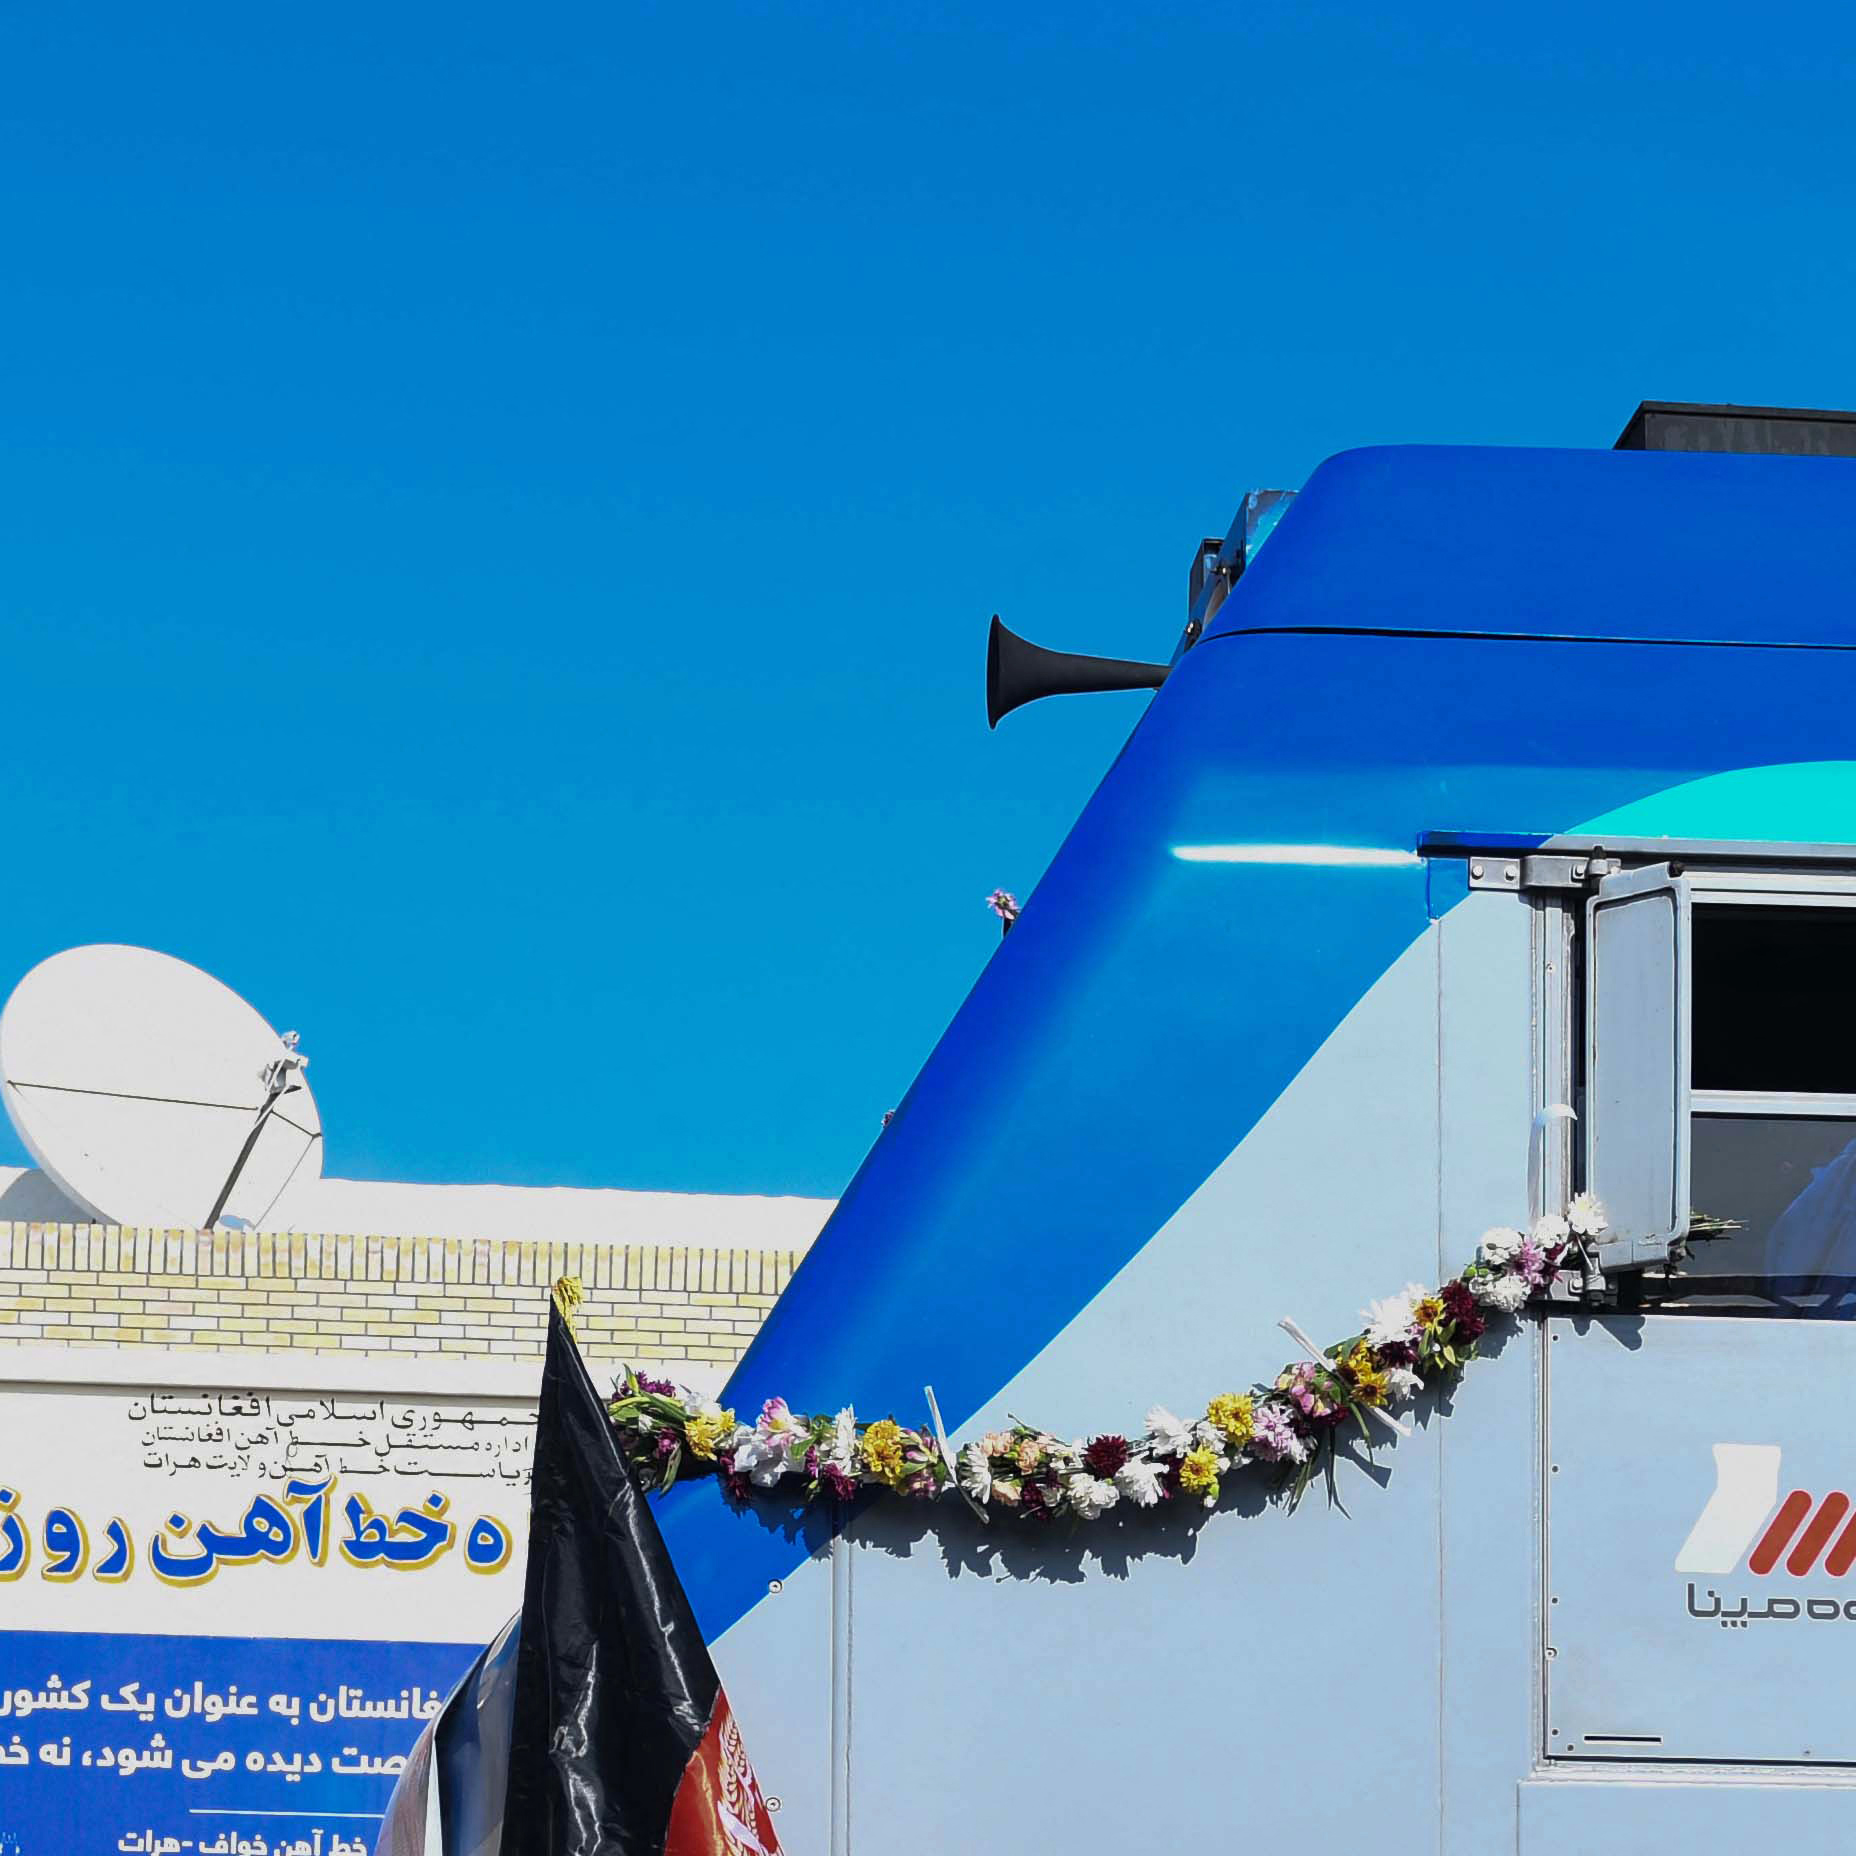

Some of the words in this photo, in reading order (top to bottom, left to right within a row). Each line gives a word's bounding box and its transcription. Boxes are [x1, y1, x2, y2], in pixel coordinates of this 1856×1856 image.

[128, 1390, 272, 1421] افغانستان
[276, 1396, 385, 1428] اسلامی
[141, 1420, 232, 1447] افغانستان
[235, 1426, 280, 1451] آهن
[374, 1433, 480, 1457] مستقل
[484, 1436, 529, 1458] اداره
[143, 1452, 202, 1477] هرات
[148, 1474, 341, 1589] آهن
[340, 1488, 458, 1571] خط
[1685, 1581, 1801, 1629] مپنا
[100, 1681, 156, 1722] یک
[164, 1680, 259, 1723] عنوان
[268, 1691, 301, 1727] به
[308, 1684, 443, 1724] غانستان
[38, 1735, 72, 1767] نه
[181, 1751, 237, 1780] می
[245, 1752, 323, 1783] دیده
